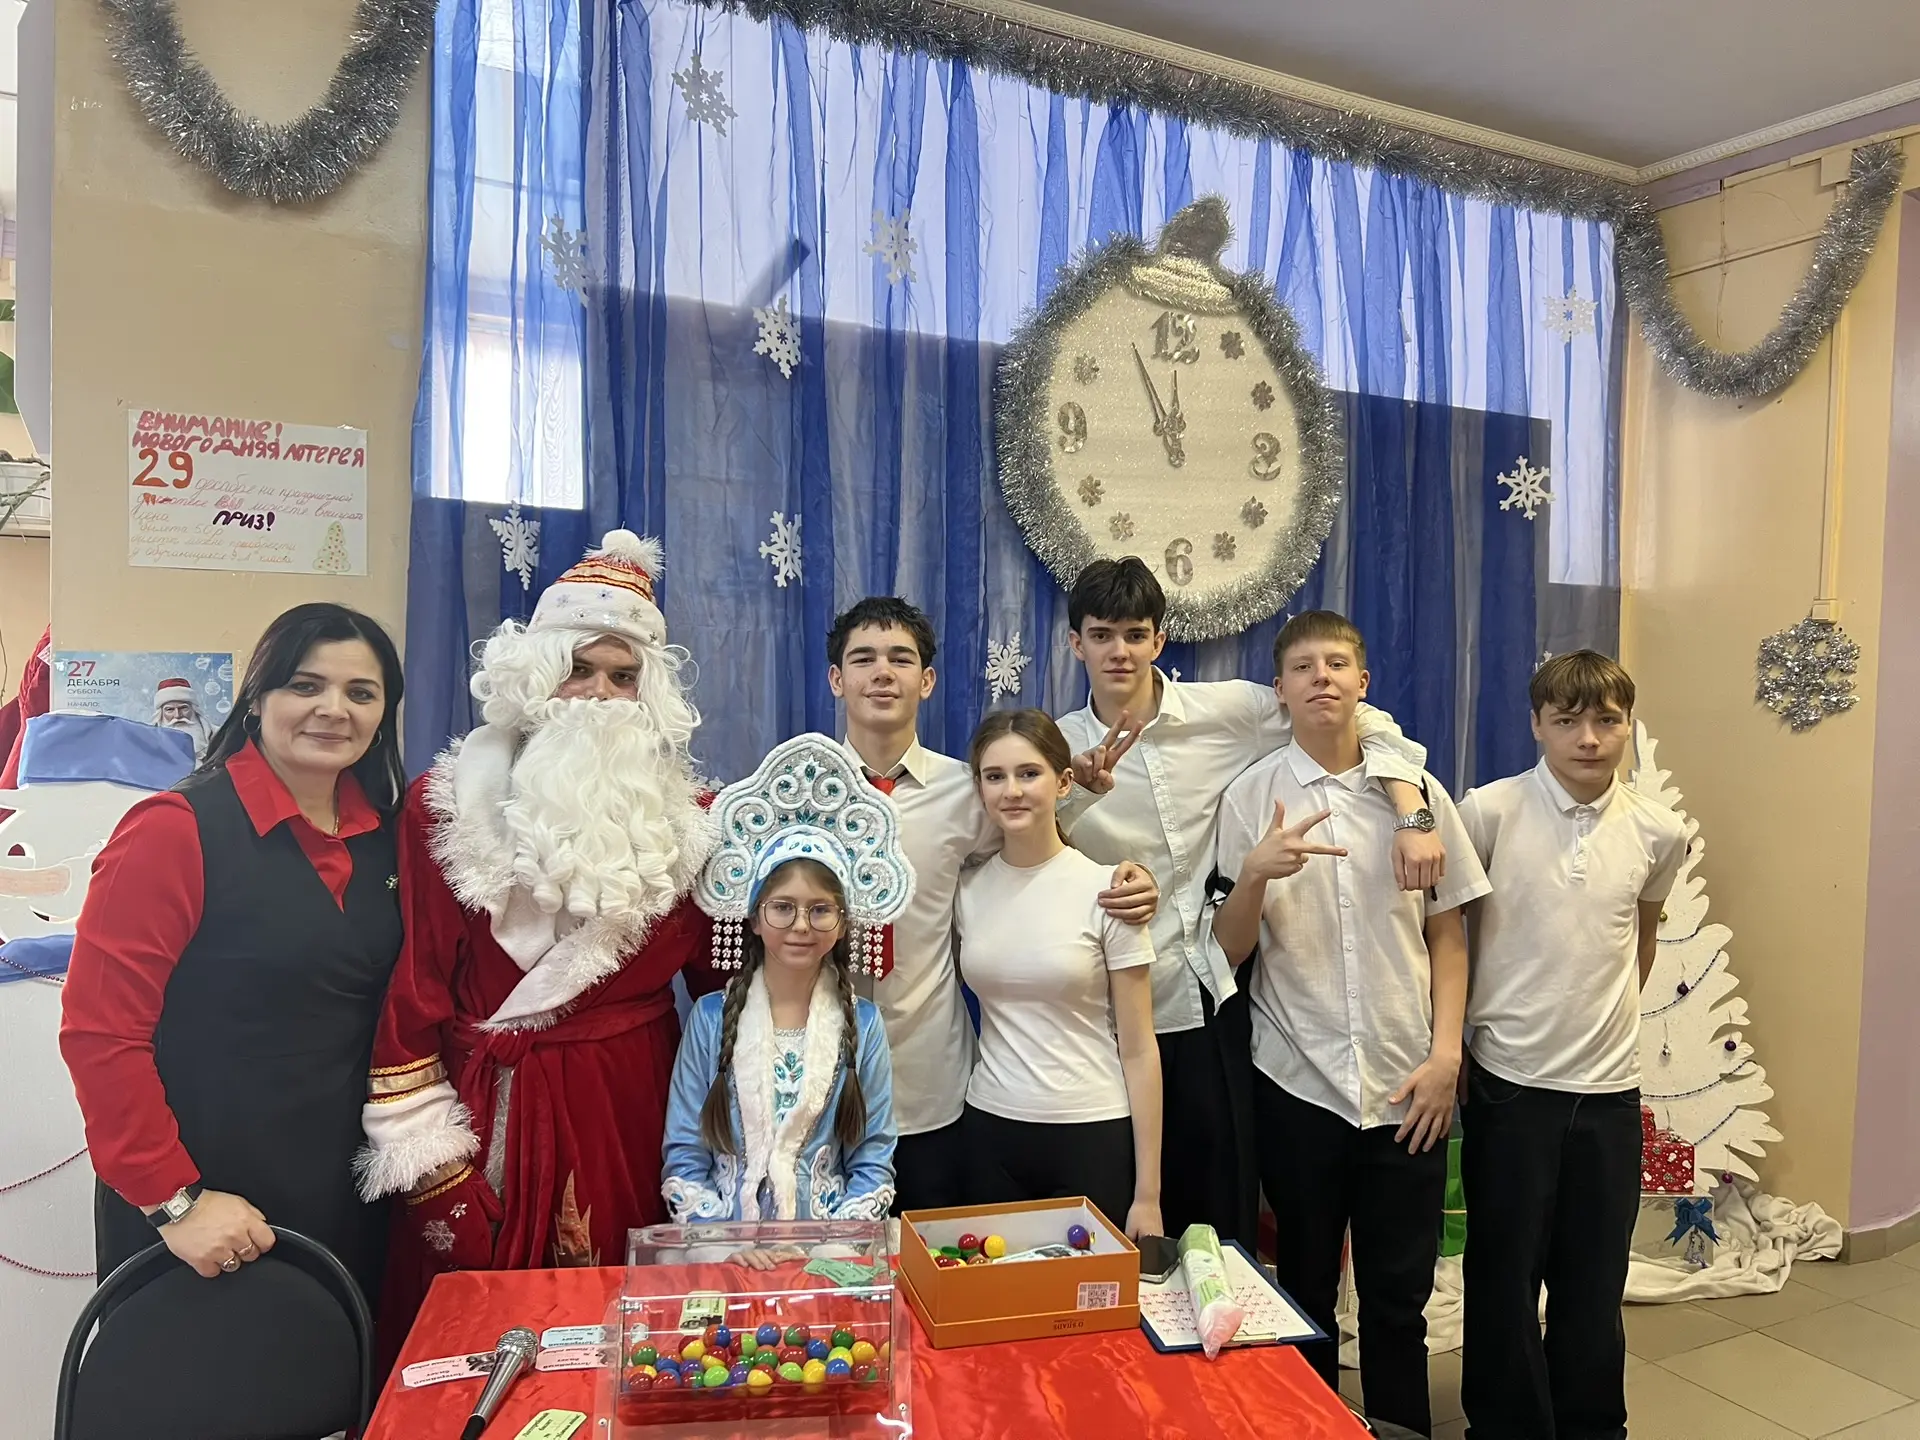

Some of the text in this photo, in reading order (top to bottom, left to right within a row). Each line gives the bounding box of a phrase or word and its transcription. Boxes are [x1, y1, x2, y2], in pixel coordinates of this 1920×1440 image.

[1149, 311, 1200, 364] 12
[1057, 402, 1088, 453] 9
[132, 448, 193, 489] 29
[1251, 432, 1282, 481] 3
[212, 510, 275, 531] ПРИЗ!
[1165, 537, 1194, 586] 6
[67, 661, 96, 676] 27
[67, 678, 120, 687] ДЕКАБРЯ
